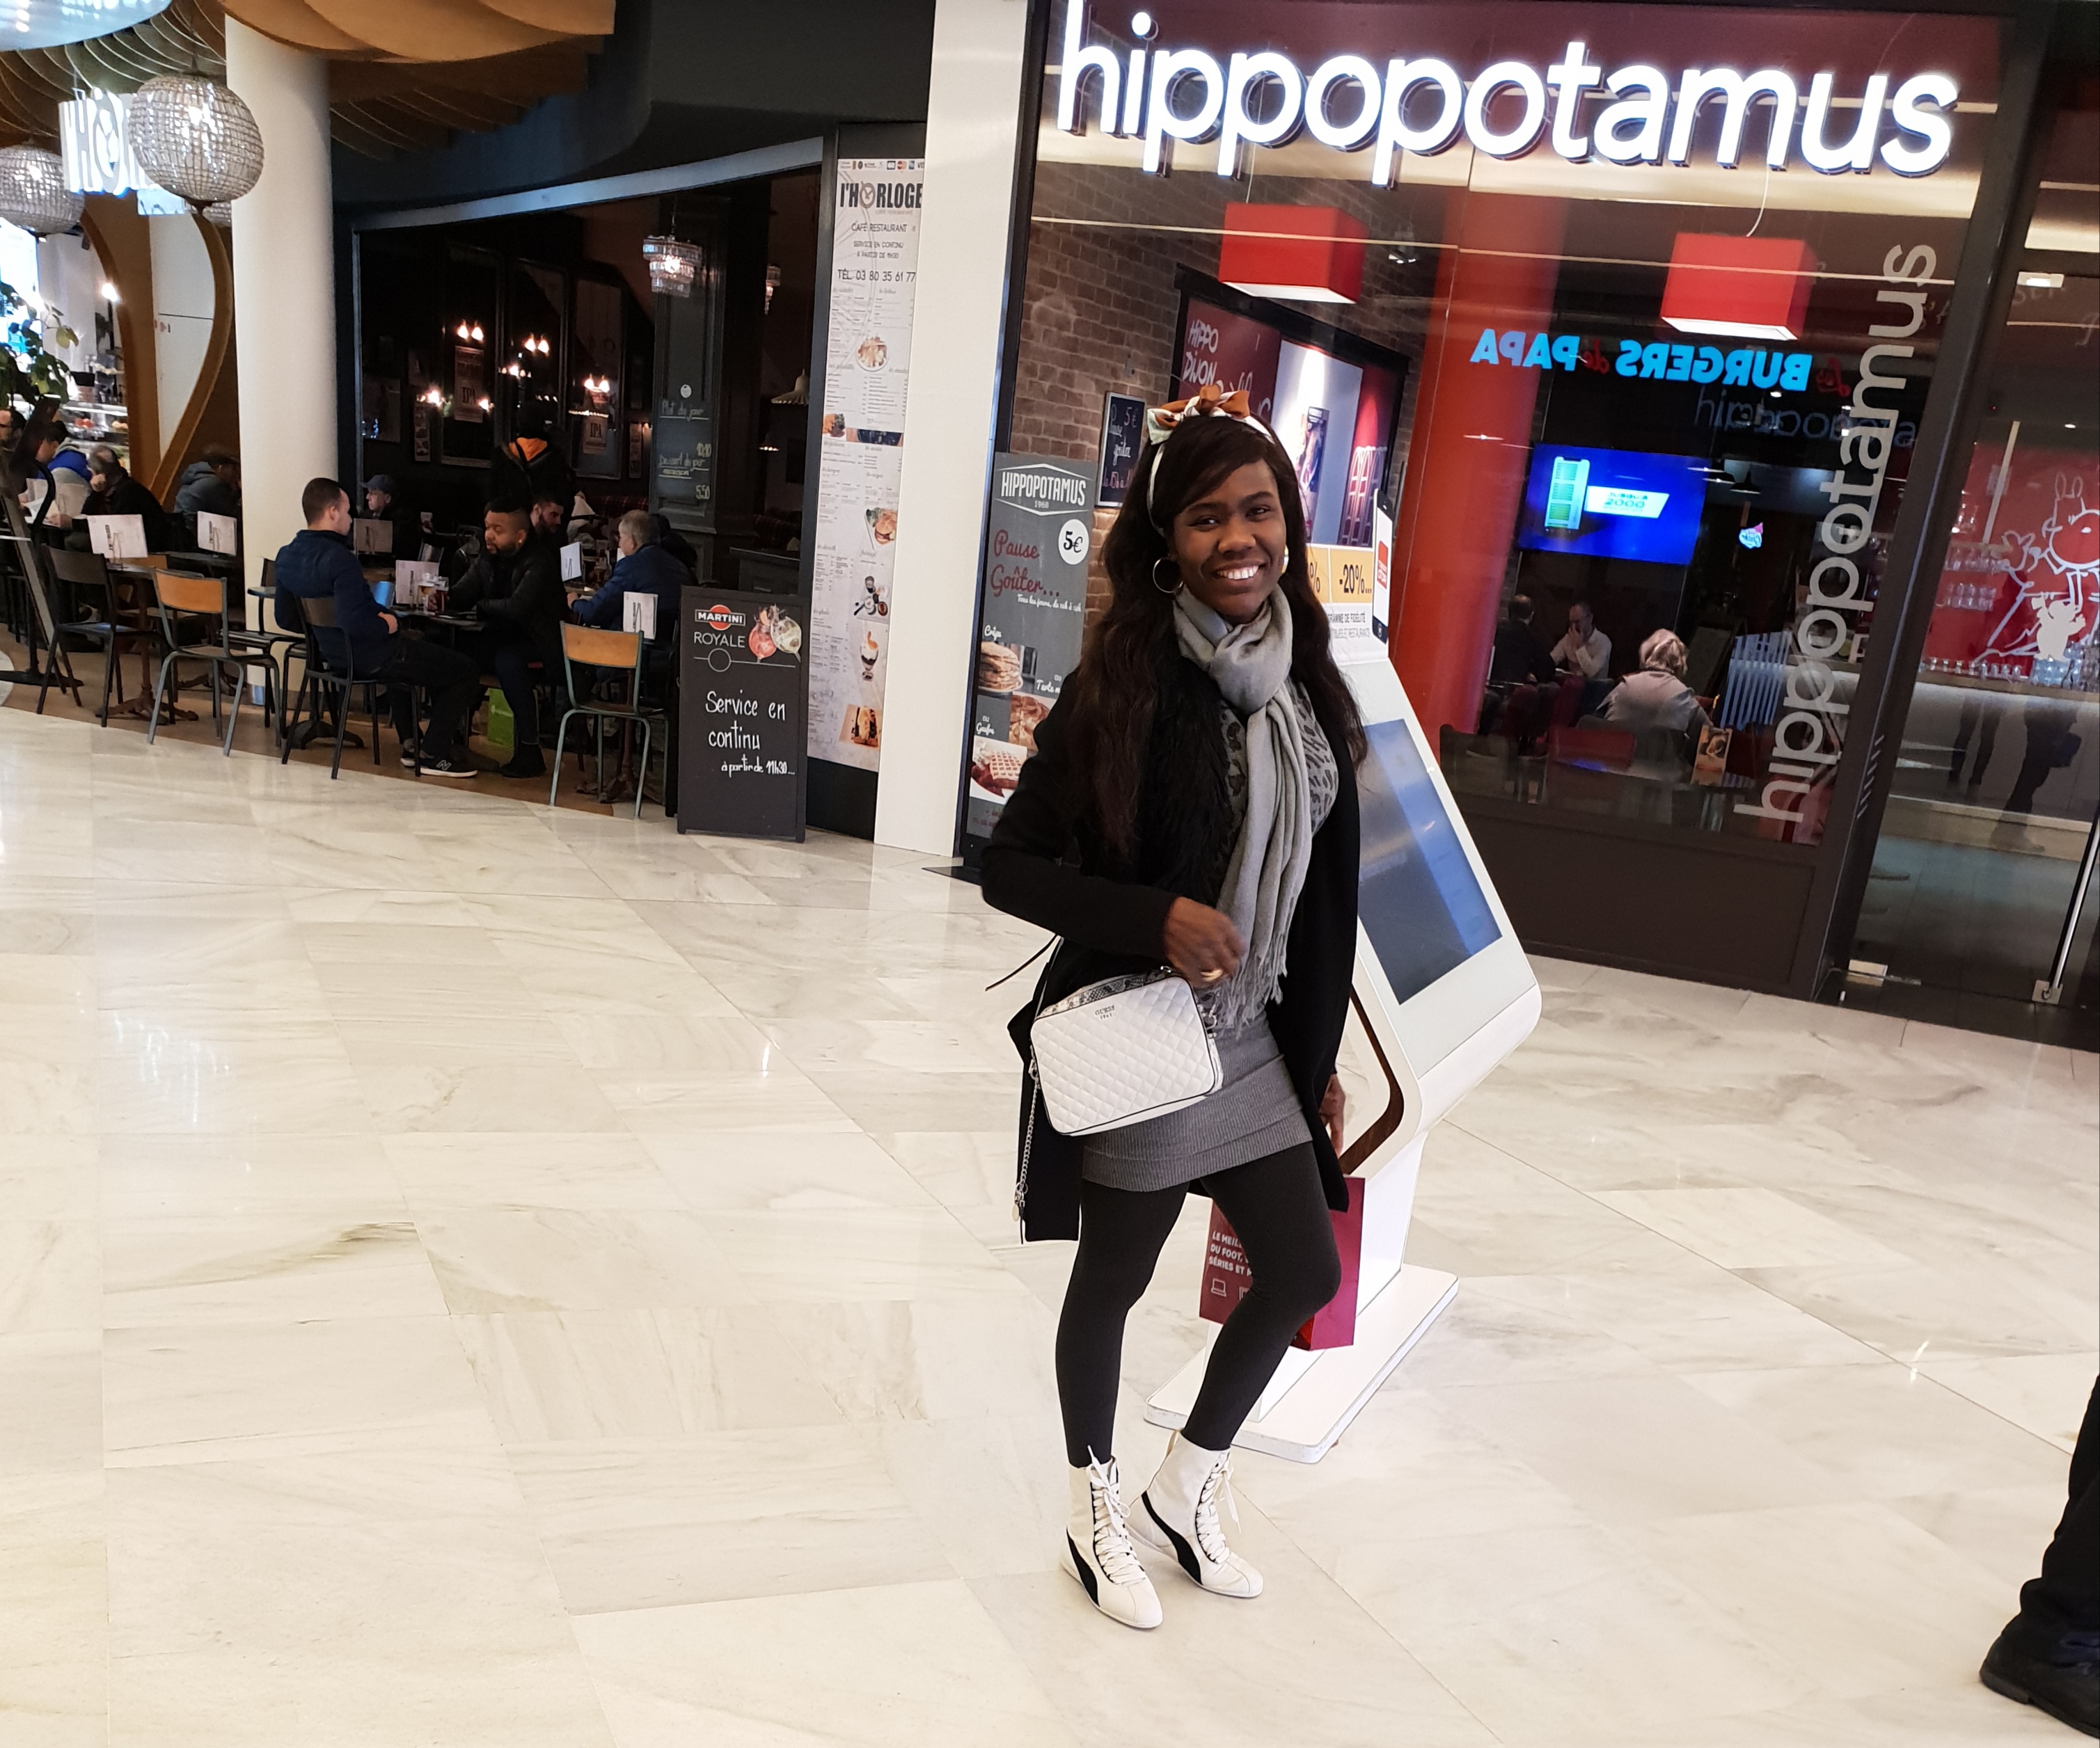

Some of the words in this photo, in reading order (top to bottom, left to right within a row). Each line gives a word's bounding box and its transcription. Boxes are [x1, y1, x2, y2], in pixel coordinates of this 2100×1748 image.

[1057, 0, 1957, 186] hippopotamus
[869, 223, 908, 232] RESTAURANT
[855, 270, 866, 280] 03
[869, 270, 879, 281] 80
[883, 271, 892, 282] 35
[895, 271, 903, 282] 61
[906, 271, 916, 283] 77
[1001, 472, 1086, 506] HIPPOPOTAMUS
[1604, 498, 1645, 509] 2000
[994, 530, 1040, 558] Pause
[1064, 531, 1083, 553] 5€
[1734, 244, 1936, 823] hippopotamus
[698, 612, 743, 624] MARTINI
[694, 632, 745, 648] ROYALE
[706, 689, 758, 717] Service
[768, 703, 786, 721] en
[709, 720, 760, 750] continu
[729, 754, 753, 779] partir
[1212, 1230, 1221, 1242] LE
[1210, 1243, 1221, 1255] DU
[1222, 1247, 1243, 1263] FOOT,
[1209, 1255, 1234, 1272] SÉRIES
[1235, 1264, 1245, 1275] ET
